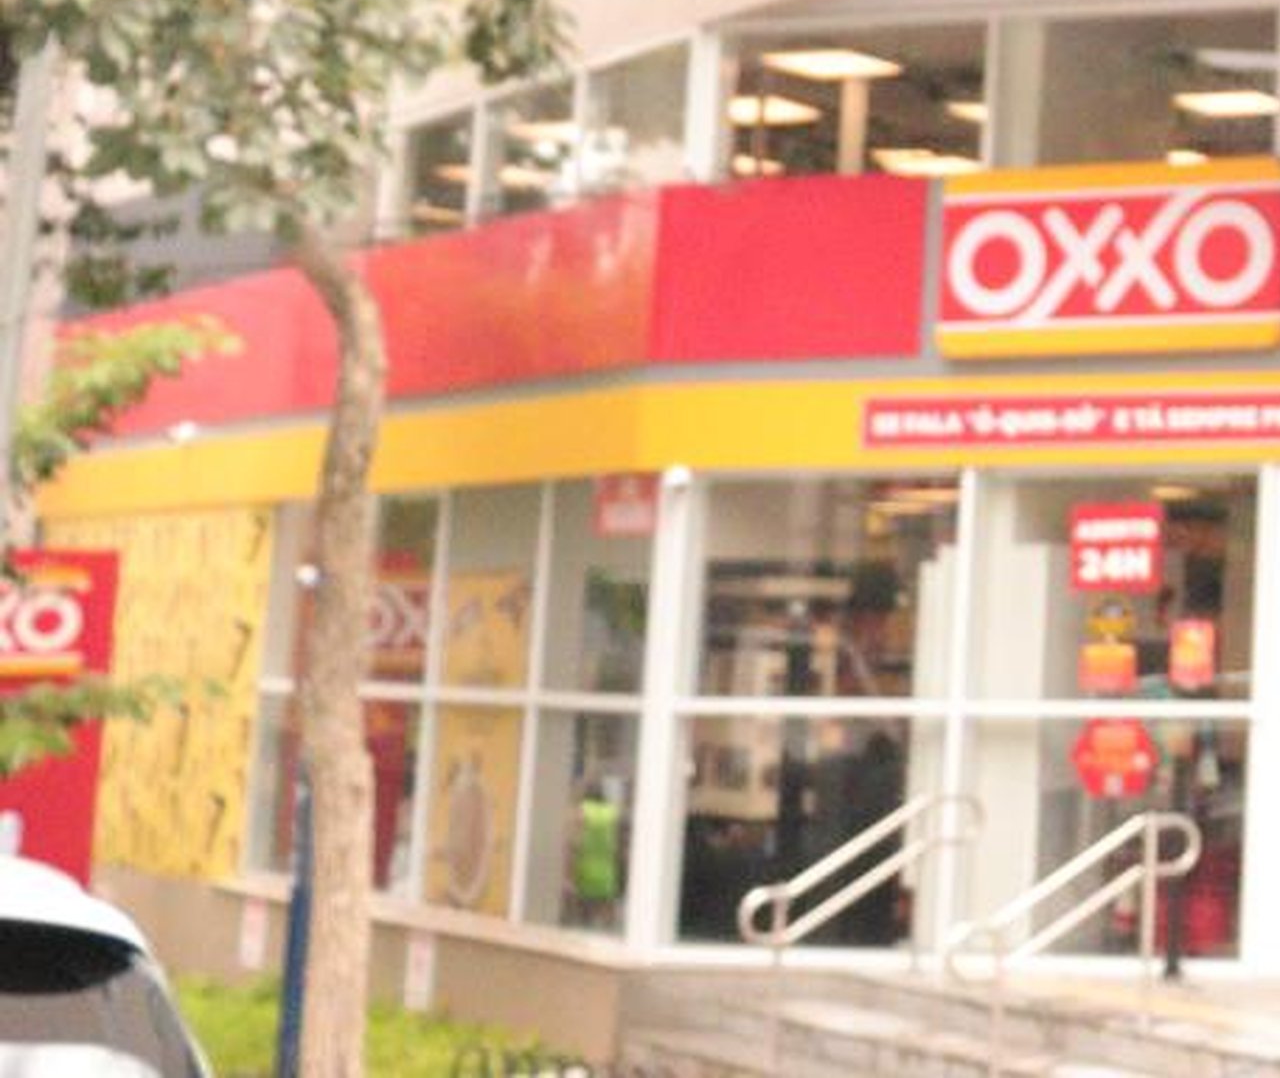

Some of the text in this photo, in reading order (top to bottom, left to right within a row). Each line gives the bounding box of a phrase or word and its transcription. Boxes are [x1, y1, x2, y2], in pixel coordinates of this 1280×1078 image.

[947, 186, 1276, 325] OXXO
[1166, 403, 1257, 431] SEMPRE
[1078, 546, 1151, 583] 24H
